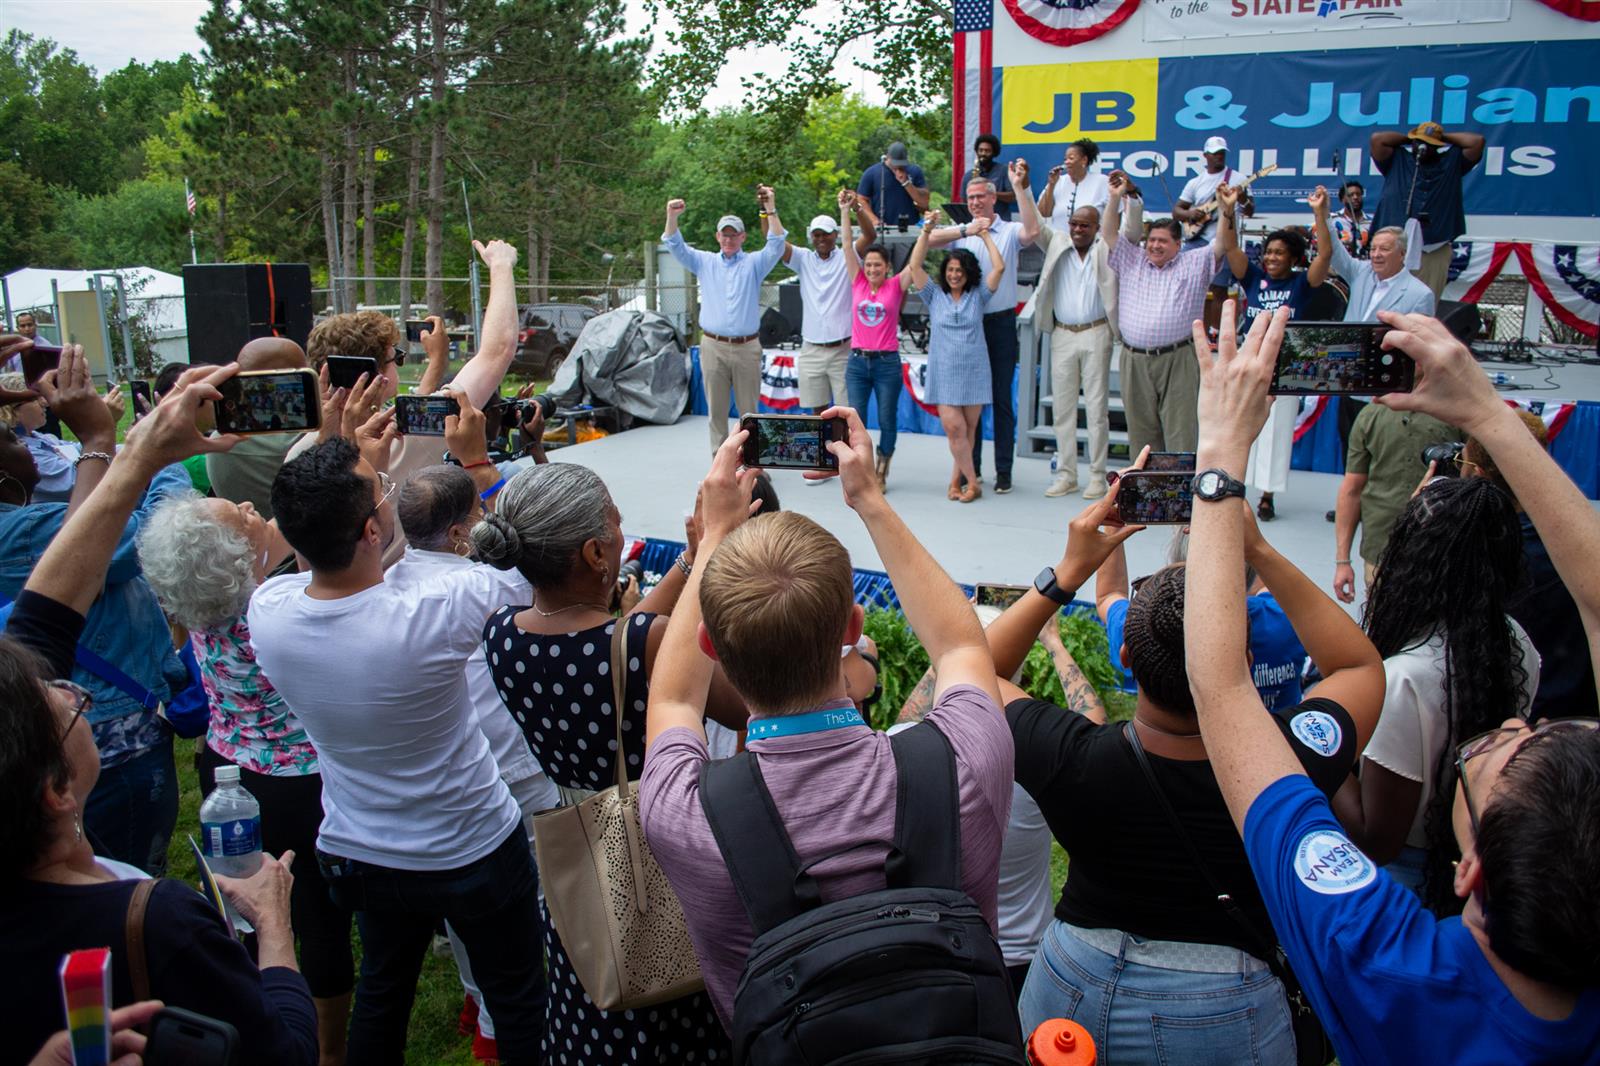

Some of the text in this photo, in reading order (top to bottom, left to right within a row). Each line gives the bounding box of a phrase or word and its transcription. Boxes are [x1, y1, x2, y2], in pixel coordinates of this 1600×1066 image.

[1170, 0, 1209, 19] to the
[1021, 74, 1600, 134] JB & Julian
[1089, 145, 1557, 178] FOR ILLIIS
[823, 712, 846, 725] The
[1304, 712, 1331, 755] SUSANA
[1303, 842, 1359, 882] SUSANA
[1329, 855, 1359, 877] TEAM
